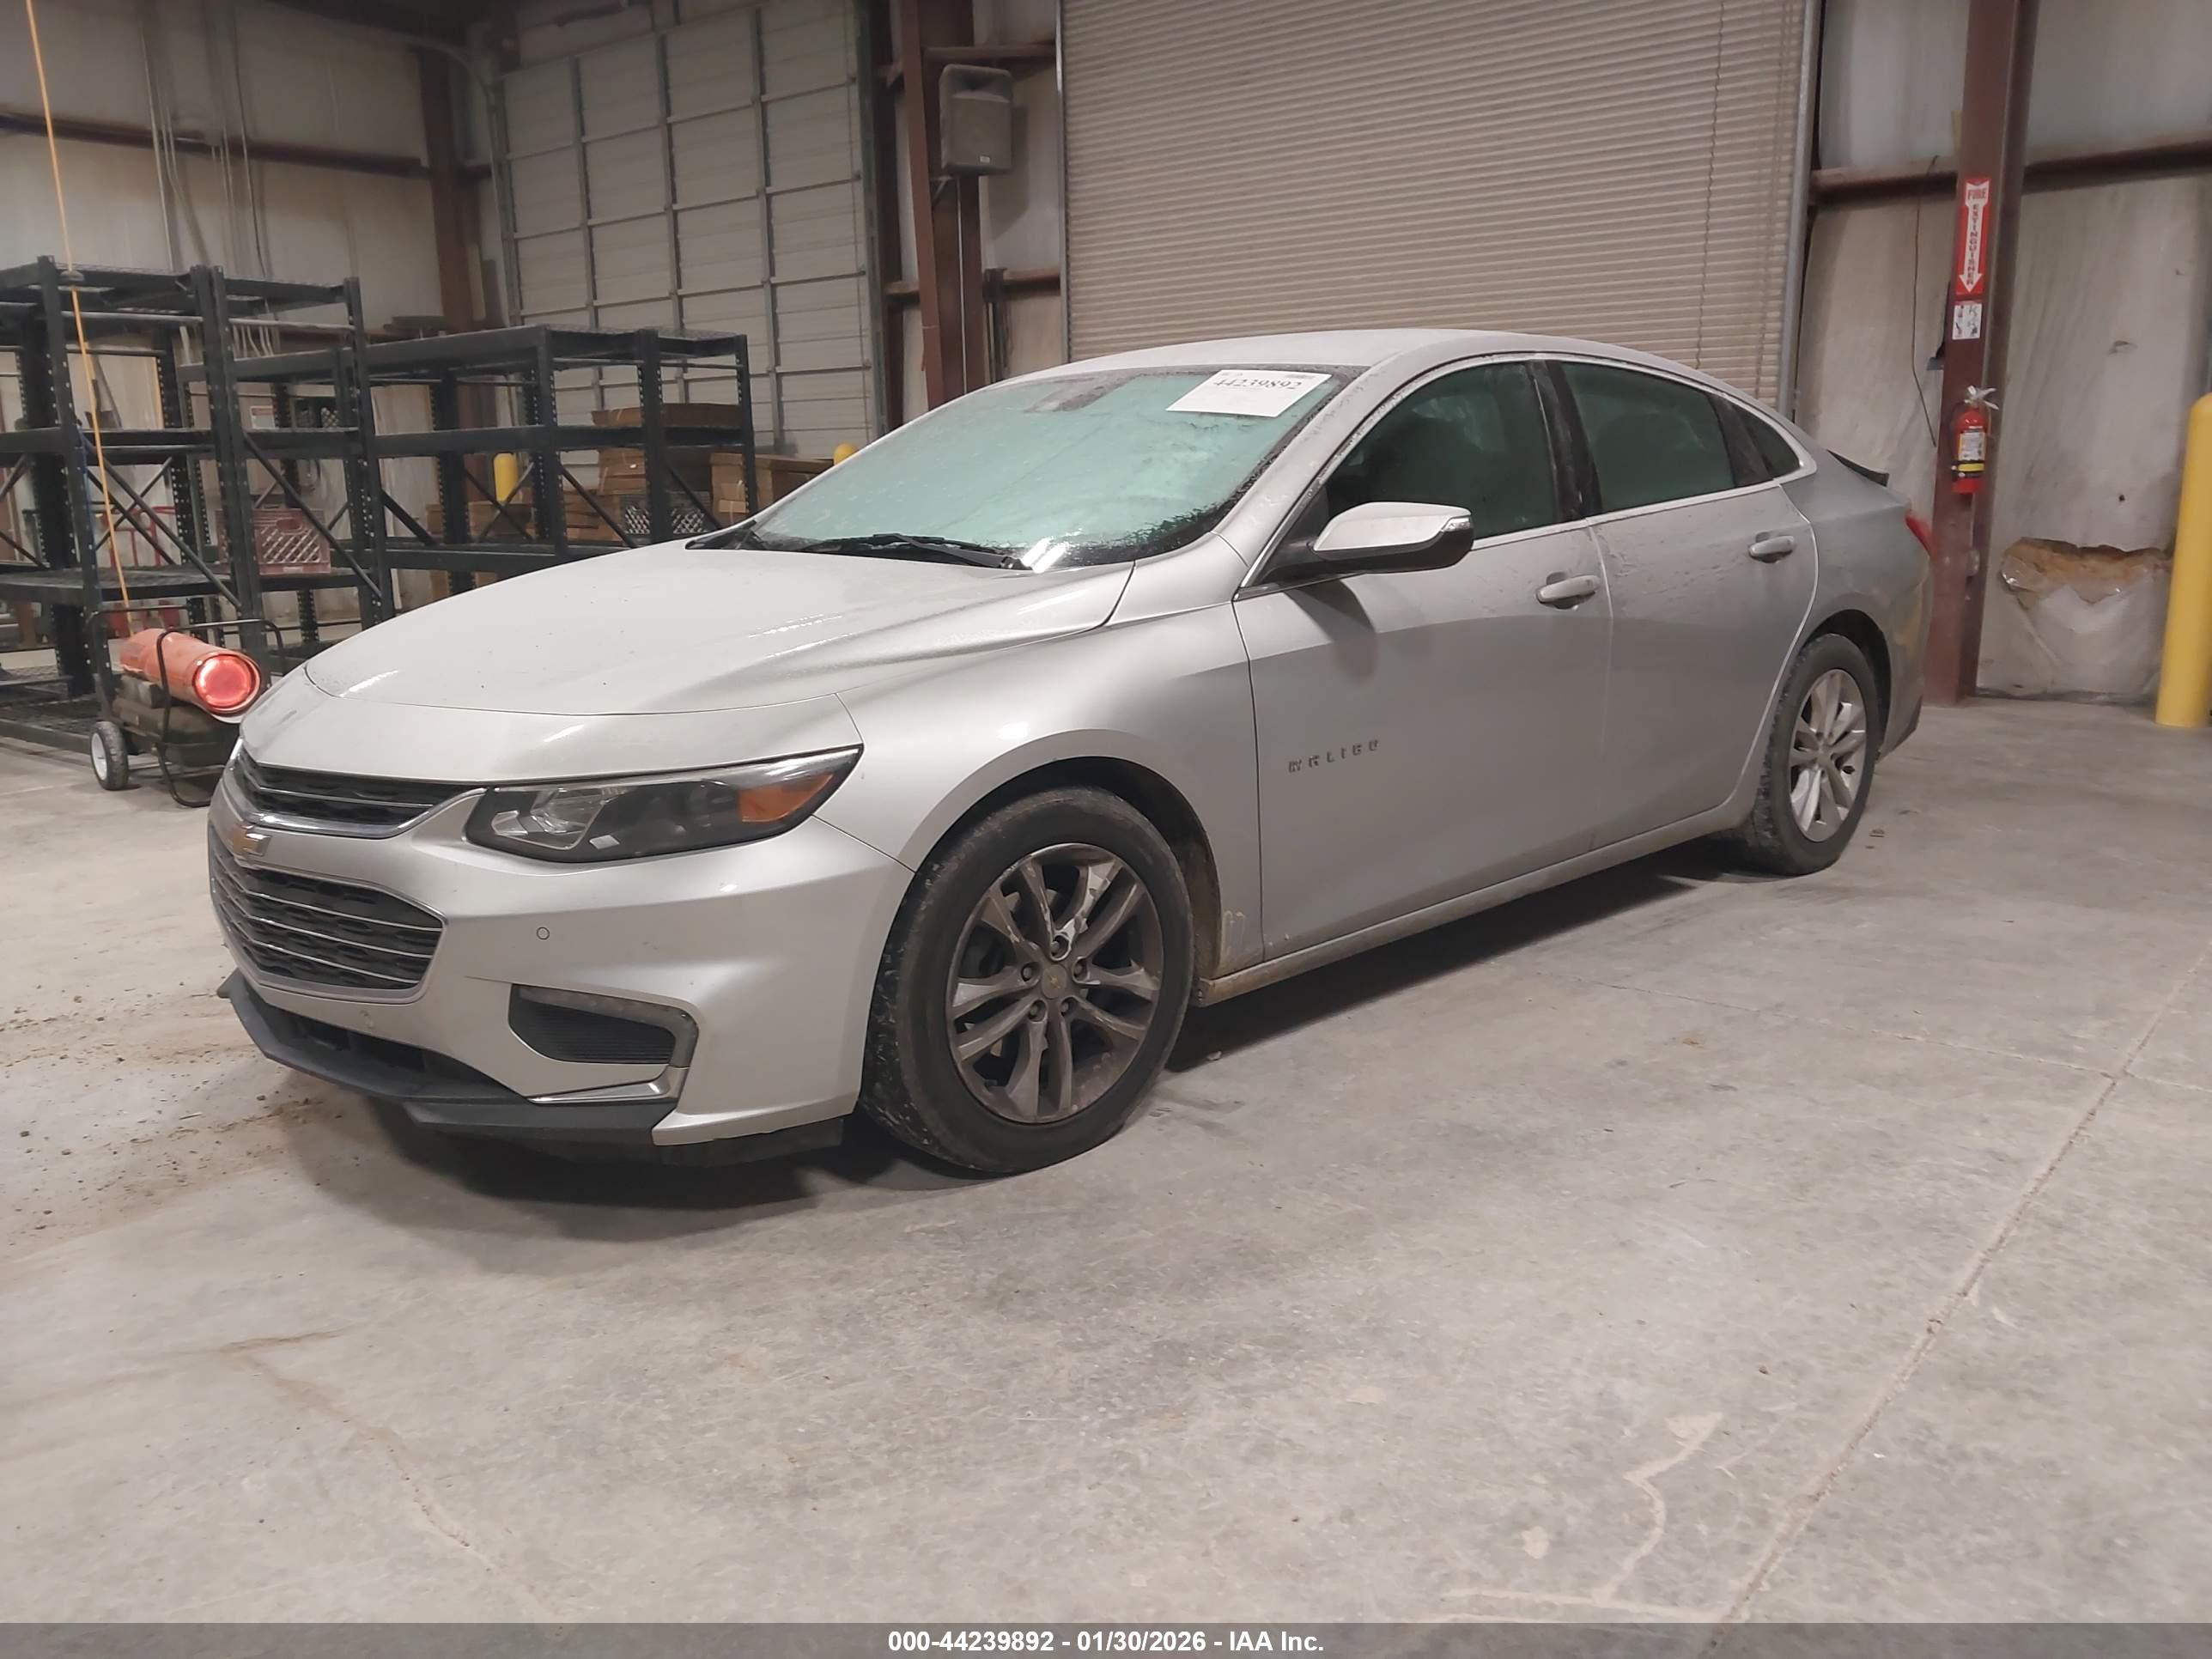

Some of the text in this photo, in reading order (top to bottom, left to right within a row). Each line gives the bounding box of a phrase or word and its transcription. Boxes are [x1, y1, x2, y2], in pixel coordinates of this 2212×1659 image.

[1967, 188, 1986, 199] FIRE
[1966, 204, 1979, 285] EXTINGUISHER
[1288, 738, 1379, 774] MALIBU
